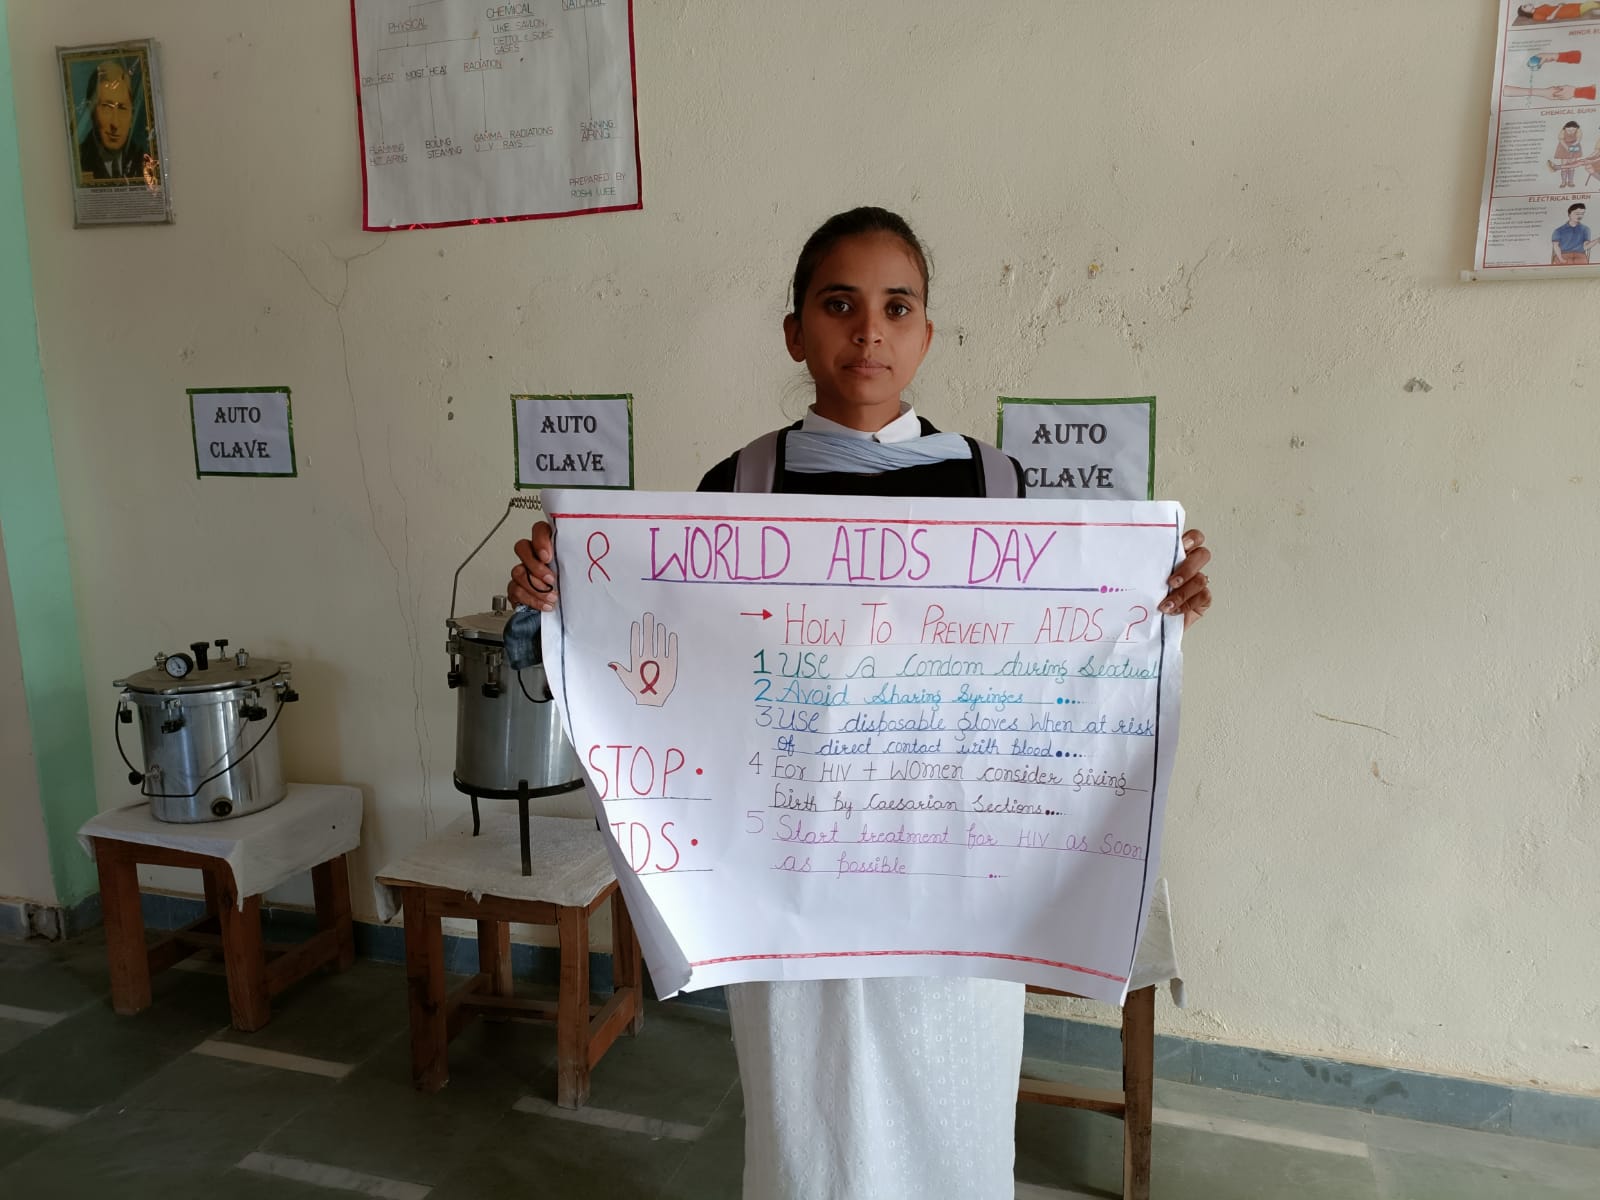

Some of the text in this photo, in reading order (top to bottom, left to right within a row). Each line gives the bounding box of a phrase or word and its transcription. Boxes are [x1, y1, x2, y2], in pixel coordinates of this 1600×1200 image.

[486, 2, 534, 19] CHEMICAL
[388, 15, 427, 34] PHYSICAL
[430, 65, 447, 76] HEAT
[464, 59, 502, 72] RADIATION
[474, 126, 554, 143] GAMMA RADIATIONS
[503, 140, 523, 150] RAYS
[569, 171, 626, 187] PREPARED BY
[1528, 195, 1570, 203] ELECTRICAL
[214, 406, 262, 424] AUTO
[540, 415, 598, 434] AUTO
[1031, 423, 1108, 445] AUTO
[209, 439, 271, 459] CLAVE
[535, 450, 605, 472] CLAVE
[1023, 463, 1114, 488] CLAVE
[649, 523, 1057, 584] WORLD AIDS DAY
[920, 603, 1015, 645] PREVENT
[1034, 606, 1104, 645] AIDS
[753, 648, 773, 674] 1
[845, 655, 876, 679] a
[993, 651, 1069, 685] during
[753, 678, 773, 702] 2
[775, 679, 849, 706] Avoid
[754, 704, 773, 727] 3
[838, 708, 948, 737] disposable
[954, 711, 1019, 741] gloves
[1081, 714, 1108, 734] at
[1111, 716, 1155, 736] risk
[813, 737, 872, 756] direct
[881, 737, 942, 755] contact
[956, 737, 1000, 755] with
[1010, 737, 1054, 757] blood
[588, 744, 686, 801] STOP
[748, 751, 764, 775] 4
[773, 754, 808, 780] For
[820, 761, 853, 781] HIV
[976, 763, 1063, 785] consider
[1072, 767, 1128, 797] giving
[833, 790, 854, 820] by
[863, 792, 959, 811] Caesarian
[745, 810, 766, 834] 5
[775, 814, 840, 844] Start
[857, 823, 951, 844] treatment
[965, 822, 998, 850] for
[1016, 828, 1051, 848] HIV
[1066, 833, 1089, 851] as
[610, 821, 680, 874] IDS
[774, 850, 907, 880] as possible
